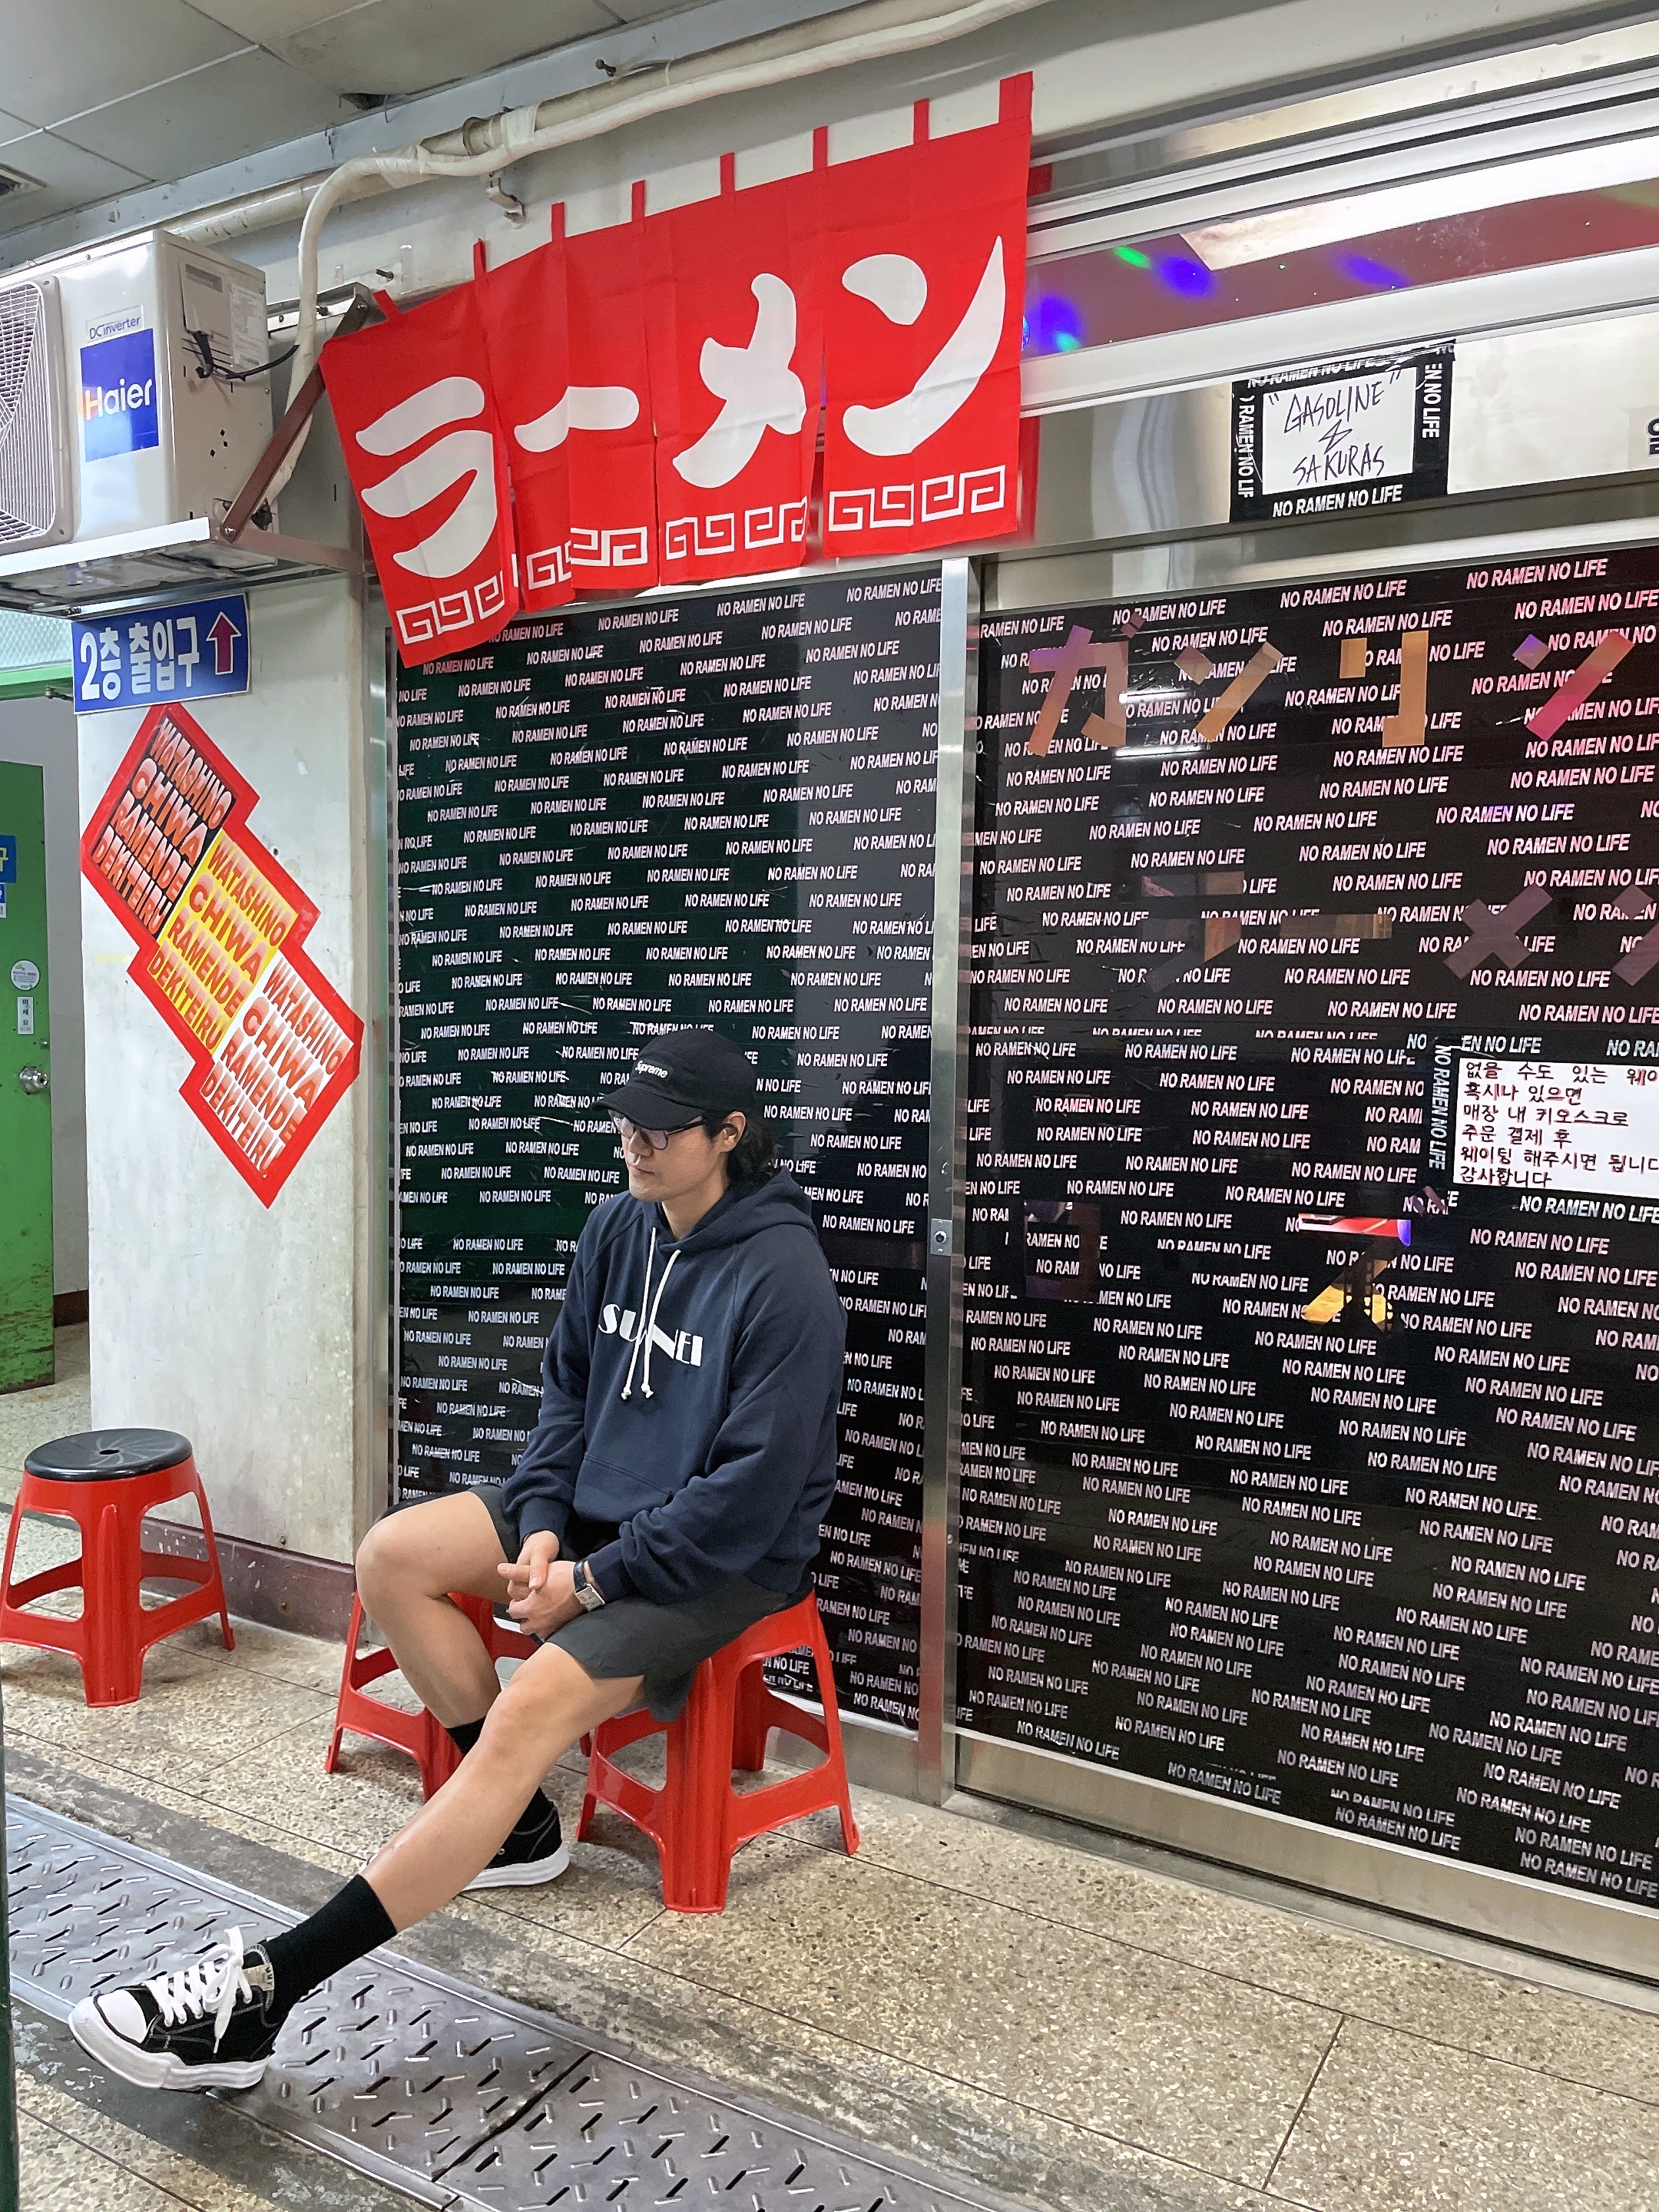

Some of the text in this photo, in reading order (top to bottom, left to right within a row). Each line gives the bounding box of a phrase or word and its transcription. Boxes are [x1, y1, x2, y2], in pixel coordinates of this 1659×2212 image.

[85, 377, 153, 421] Haier
[355, 235, 1005, 578] ラーメン
[1423, 384, 1442, 405] NO
[1238, 404, 1255, 454] RAMEN
[1422, 407, 1440, 439] LIFE
[1237, 455, 1254, 477] NO
[1272, 484, 1403, 517] NO RAMEN NO LIFE
[717, 593, 805, 616] NO RAMEN NO LIFE
[1280, 580, 1406, 608] NO RAMEN NO LIFE
[1323, 610, 1452, 637] NO RAMEN NO LIFE
[80, 616, 200, 700] 2층 출입구
[806, 641, 899, 663] NO RAMEN NO LIFE
[664, 737, 747, 755] NO RAMEN NO LIFE
[150, 718, 232, 830] WATASHINO
[1510, 765, 1655, 788] NO RAMEN NO LIFE
[763, 783, 853, 803] NO RAMEN NO LIFE
[132, 757, 207, 868] CHIWA
[1436, 803, 1575, 823] NO RAMEN NO LIFE
[112, 791, 191, 903] RAMENDE
[1487, 834, 1631, 855] NO RAMEN NO LIFE
[92, 826, 172, 934] DEKITEIRU
[207, 836, 291, 946] WATASHINO
[1333, 873, 1462, 891] NO RAMEN NO LIFE
[190, 872, 268, 984] CHIWA
[608, 921, 687, 935] NO RAMEN NO LIFE
[167, 906, 252, 1018] RAMENDE
[767, 945, 856, 959] NO RAMEN NO LIFE
[1470, 970, 1611, 987] NO RAMEN NO LIFE
[149, 941, 228, 1050] DEKITEIRU
[263, 958, 351, 1075] WATASHINO
[243, 997, 324, 1111] CHIWA
[1406, 1034, 1427, 1049] NO
[1485, 1036, 1507, 1052] NO
[1509, 1037, 1542, 1054] LIFE
[1606, 1039, 1631, 1056] NO
[635, 1060, 668, 1078] Supreme
[1466, 1062, 1503, 1080] 없을
[1517, 1061, 1555, 1081] 수도
[1572, 1065, 1608, 1084] 있는
[220, 1028, 307, 1145] RAMENDE
[1464, 1082, 1582, 1105] 혹시나 있으면
[200, 1061, 285, 1175] DEKITEIRU
[1429, 1045, 1452, 1171] NO RAMEN NO LIFE
[1463, 1104, 1629, 1127] 매장 내 키오스크로
[1462, 1124, 1572, 1150] 주문 결제 후
[1460, 1146, 1512, 1164] 웨이팅
[1523, 1150, 1597, 1171] 해주시면
[1460, 1167, 1552, 1187] 감사합니다
[1519, 1196, 1659, 1224] NO RAMEN NO LIFE
[469, 1311, 538, 1323] NO RAMEN NO LIFE
[1435, 1346, 1570, 1373] NO RAMEN NO LIFE
[1144, 1373, 1256, 1396] NO RAMEN NO LIFE
[1368, 1452, 1497, 1481] NO RAMEN NO LIFE
[1230, 1469, 1349, 1495] NO RAMEN NO LIFE
[1452, 1555, 1587, 1591] NO RAMEN NO LIFE
[1301, 1724, 1425, 1762] NO RAMEN NO LIFE
